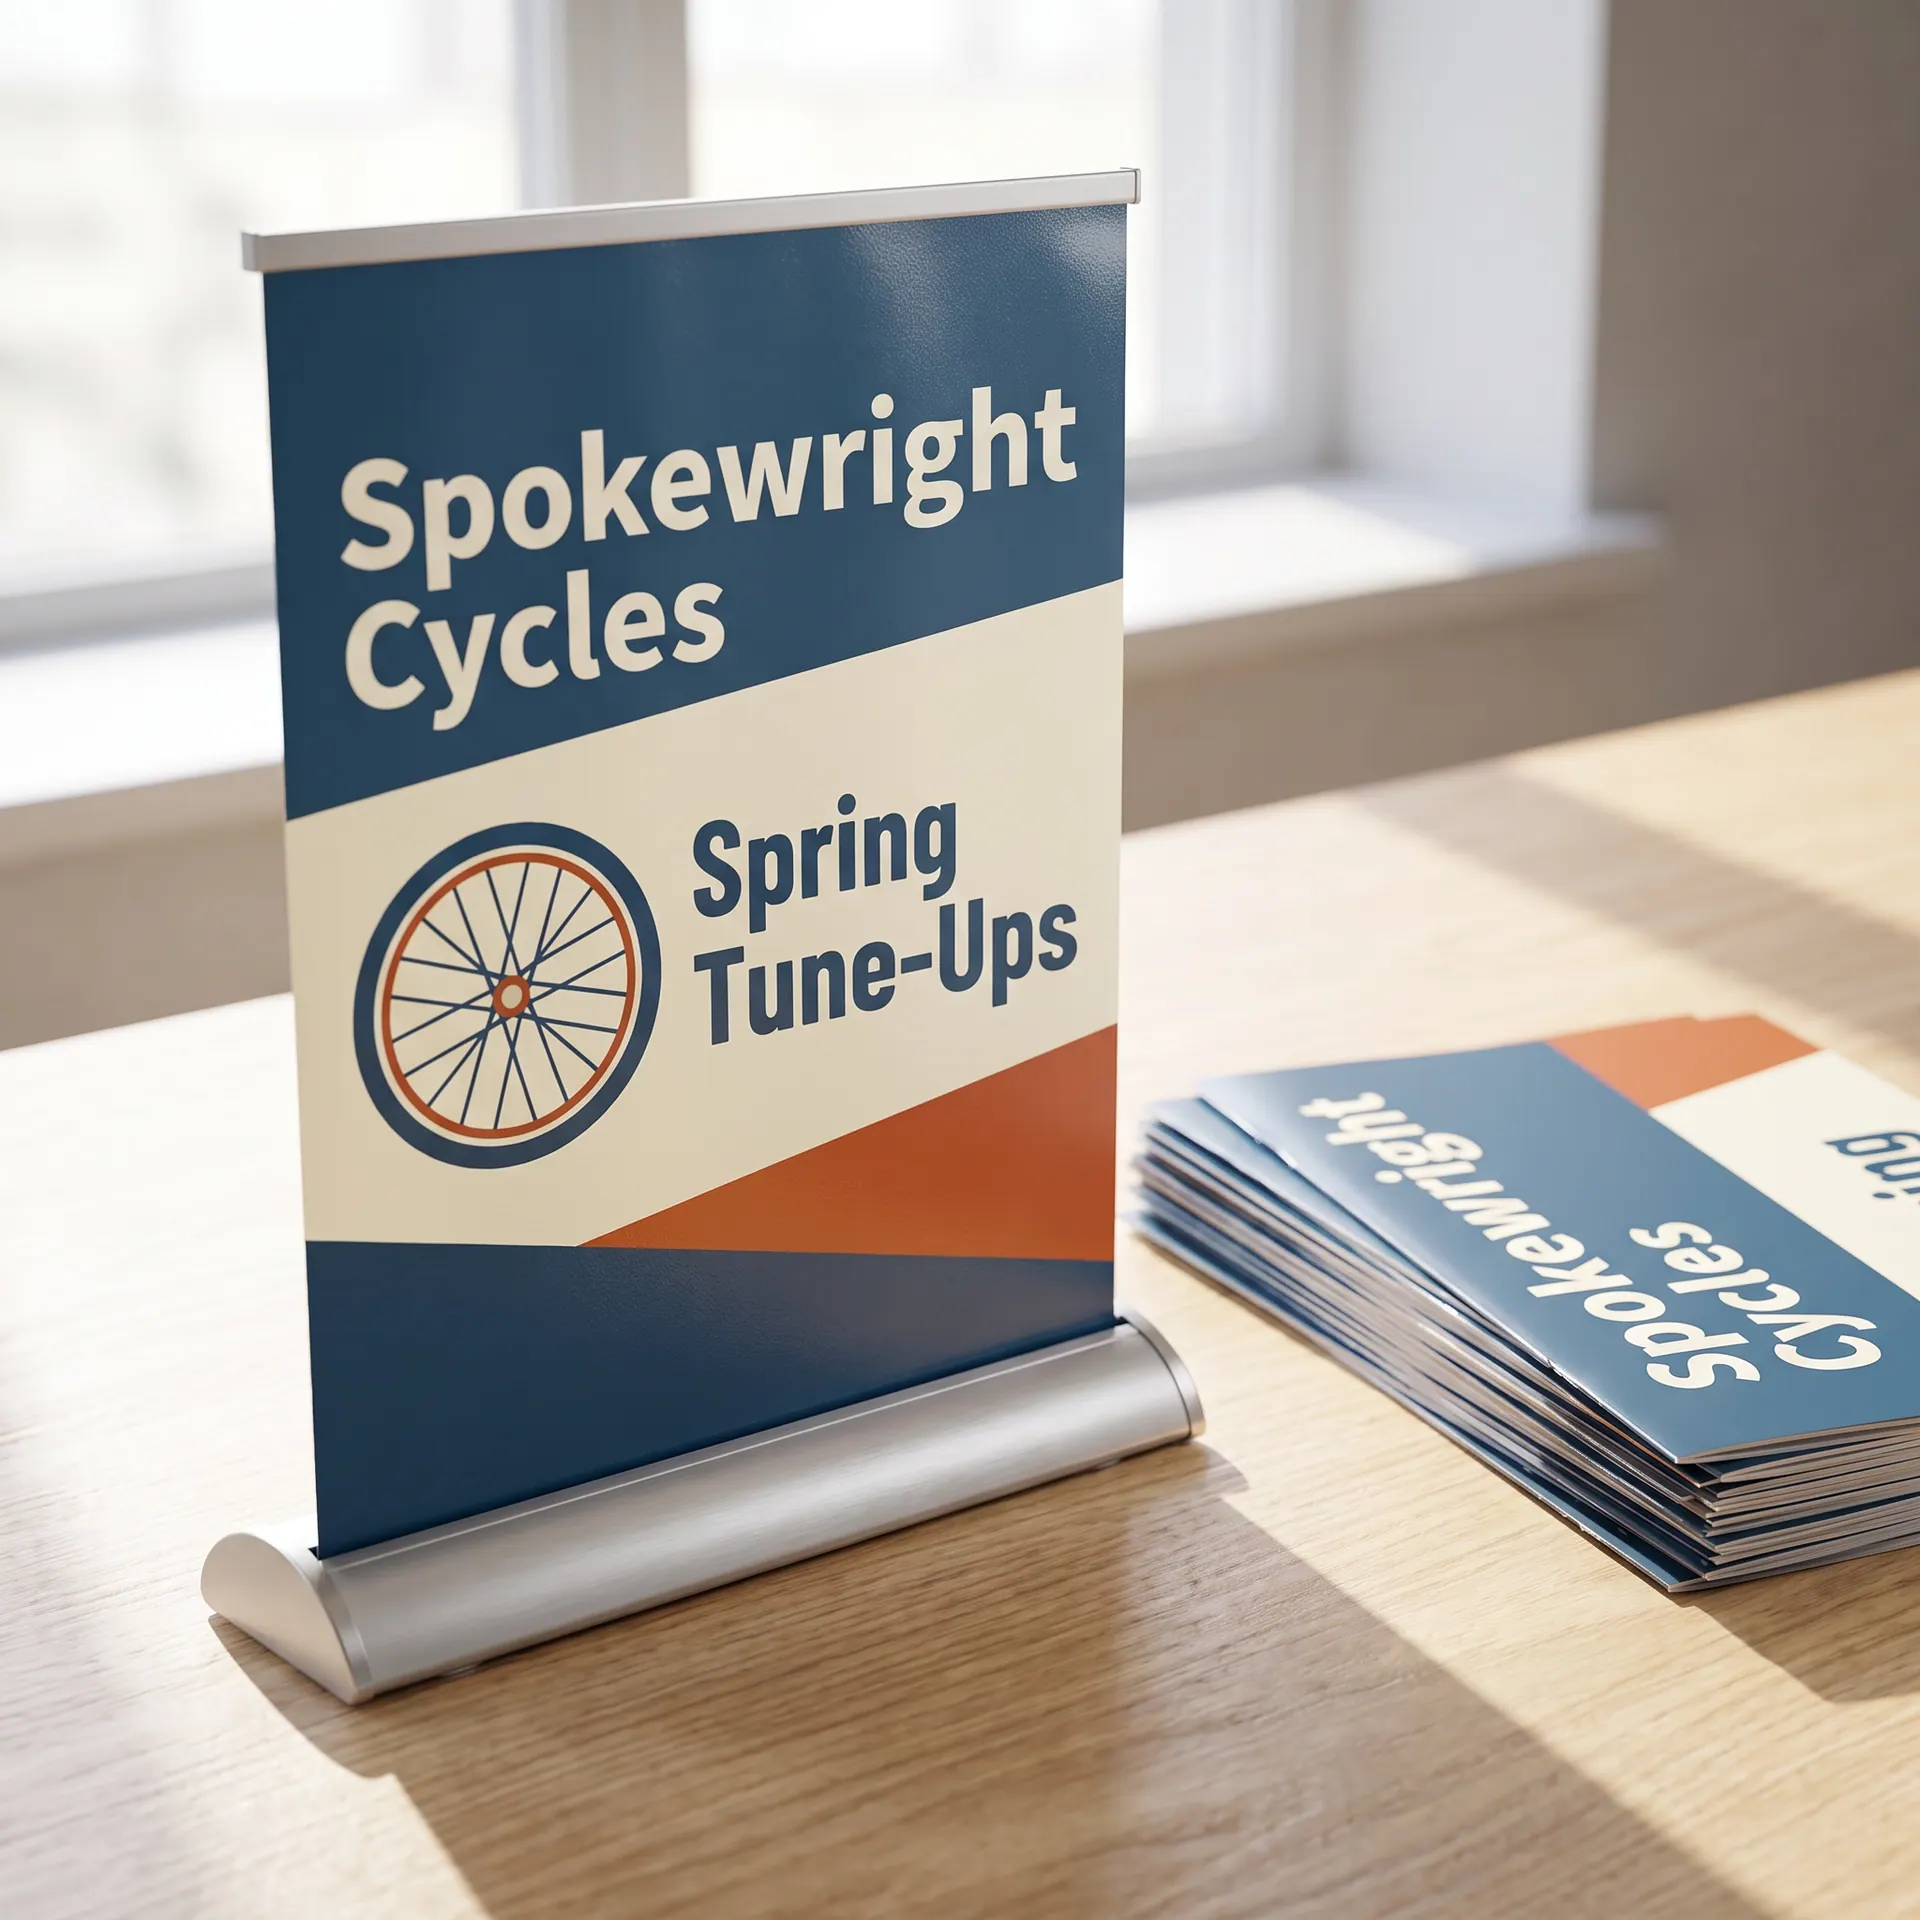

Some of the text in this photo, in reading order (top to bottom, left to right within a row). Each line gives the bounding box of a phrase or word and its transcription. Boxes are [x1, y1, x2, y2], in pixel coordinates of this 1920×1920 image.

[341, 386, 1078, 592] Spokewright
[345, 569, 726, 732] Cycles
[693, 794, 957, 934] Spring
[694, 898, 1079, 1046] Tune-Ups
[1299, 1091, 1761, 1389] Spokewright
[1628, 1221, 1882, 1371] Cycles
